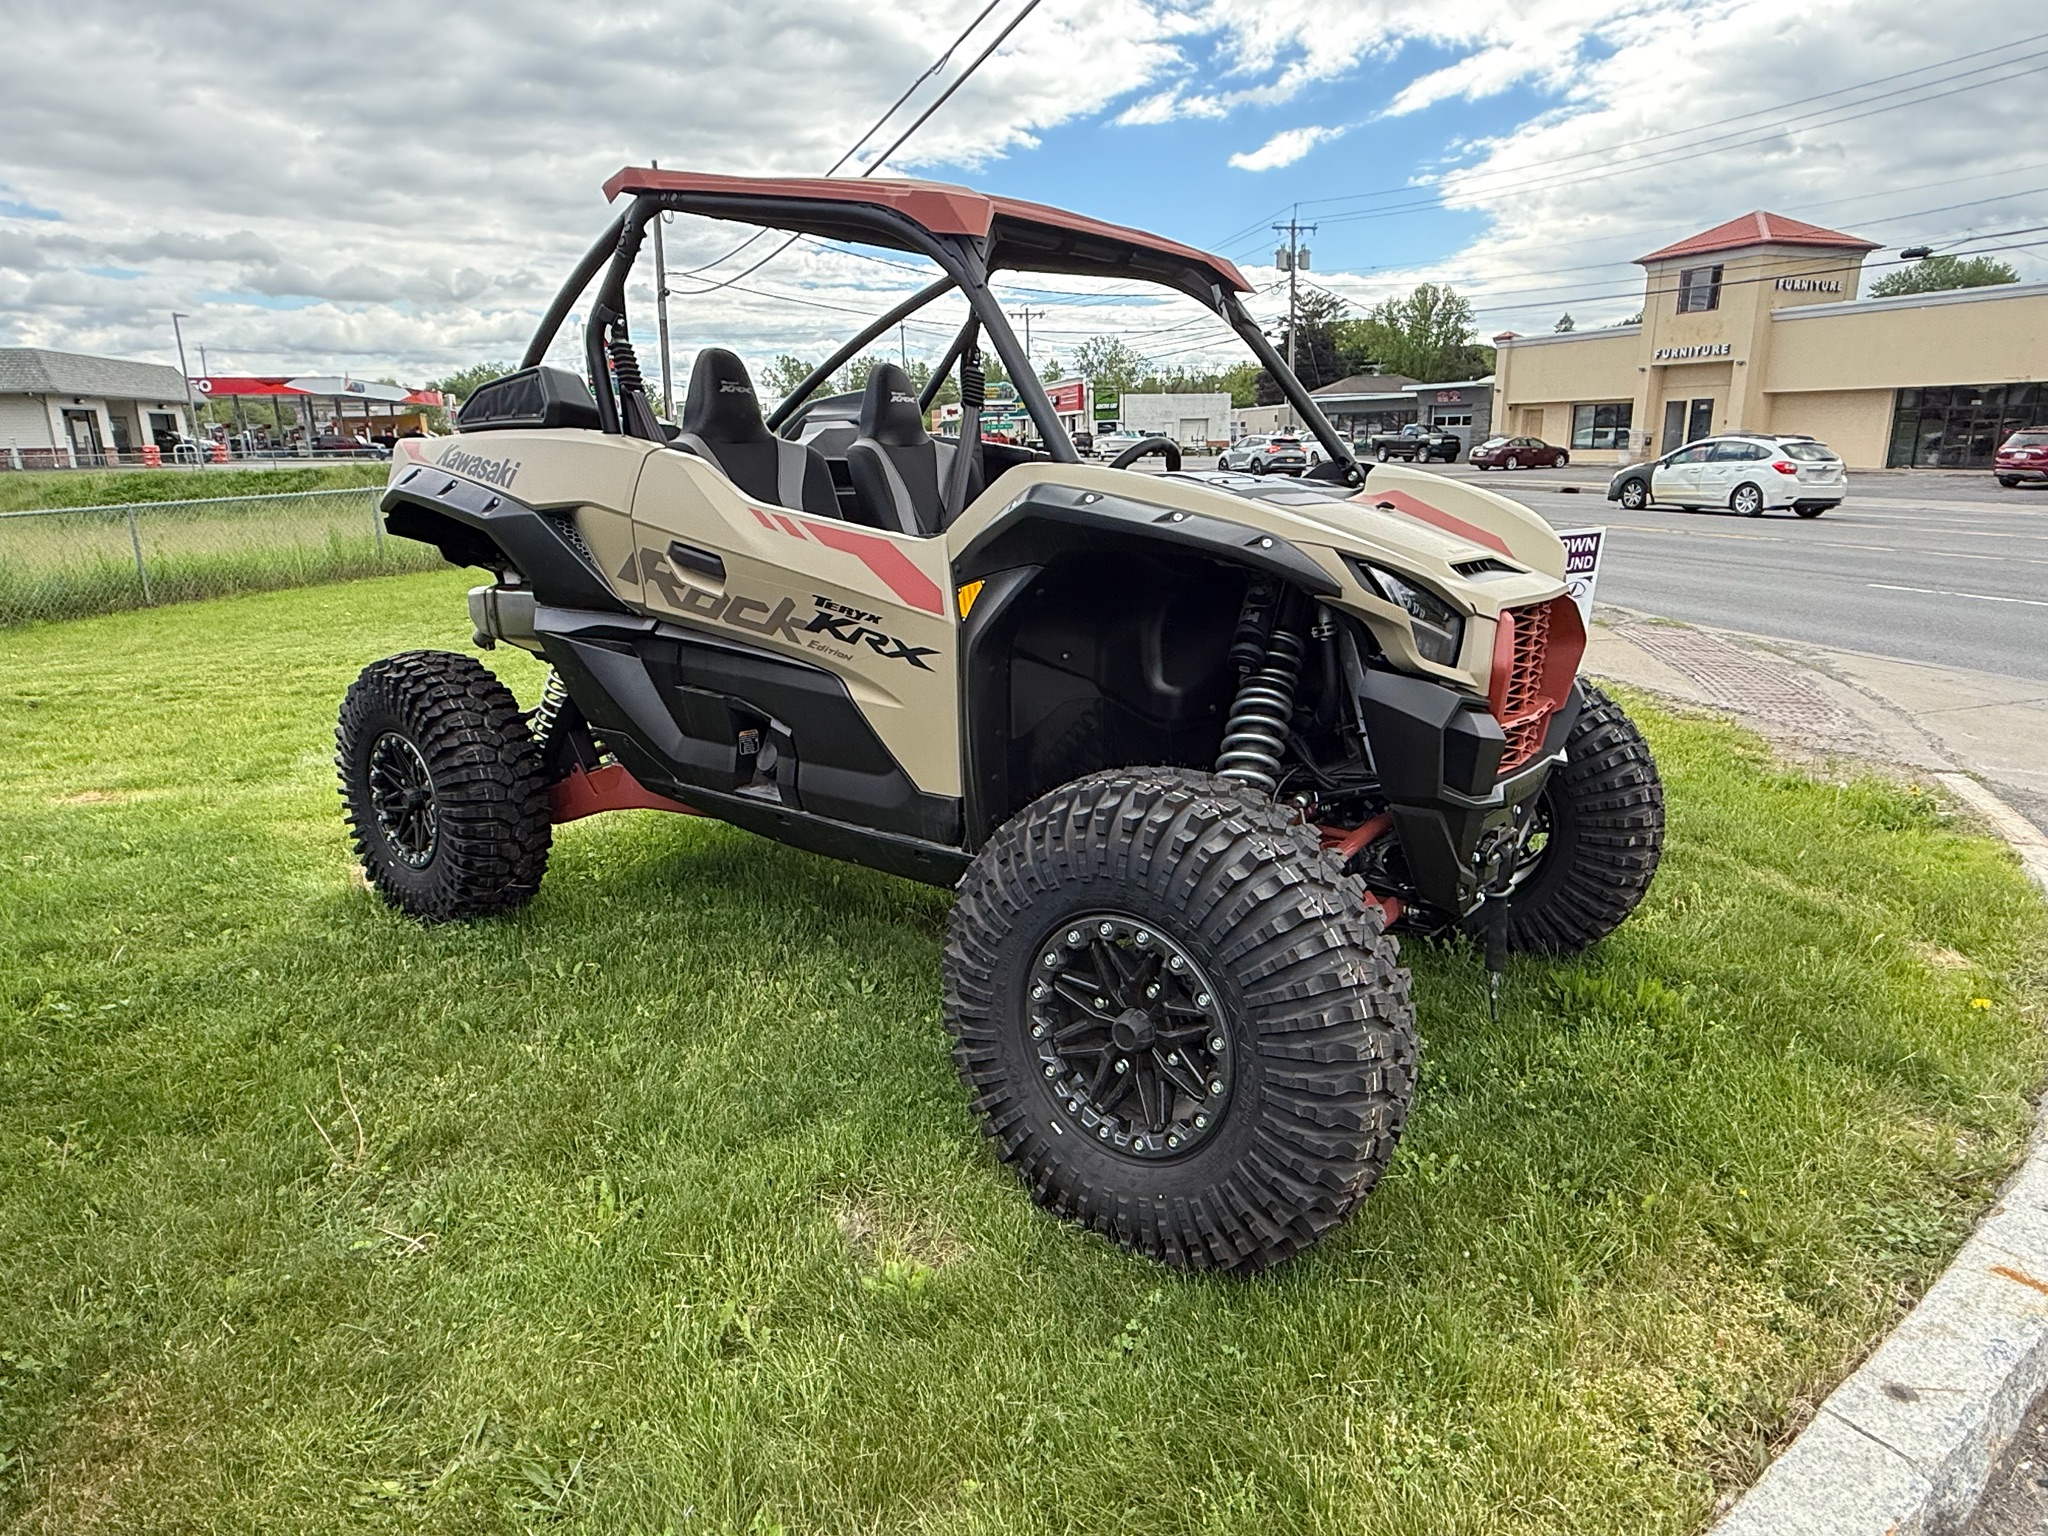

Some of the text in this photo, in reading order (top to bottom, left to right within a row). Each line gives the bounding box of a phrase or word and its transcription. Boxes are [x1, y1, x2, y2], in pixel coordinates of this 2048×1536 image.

[1775, 278, 1844, 293] FURNITURE
[1654, 344, 1731, 360] FURNITURE
[435, 443, 521, 489] Kawasaki
[804, 609, 942, 673] KRX
